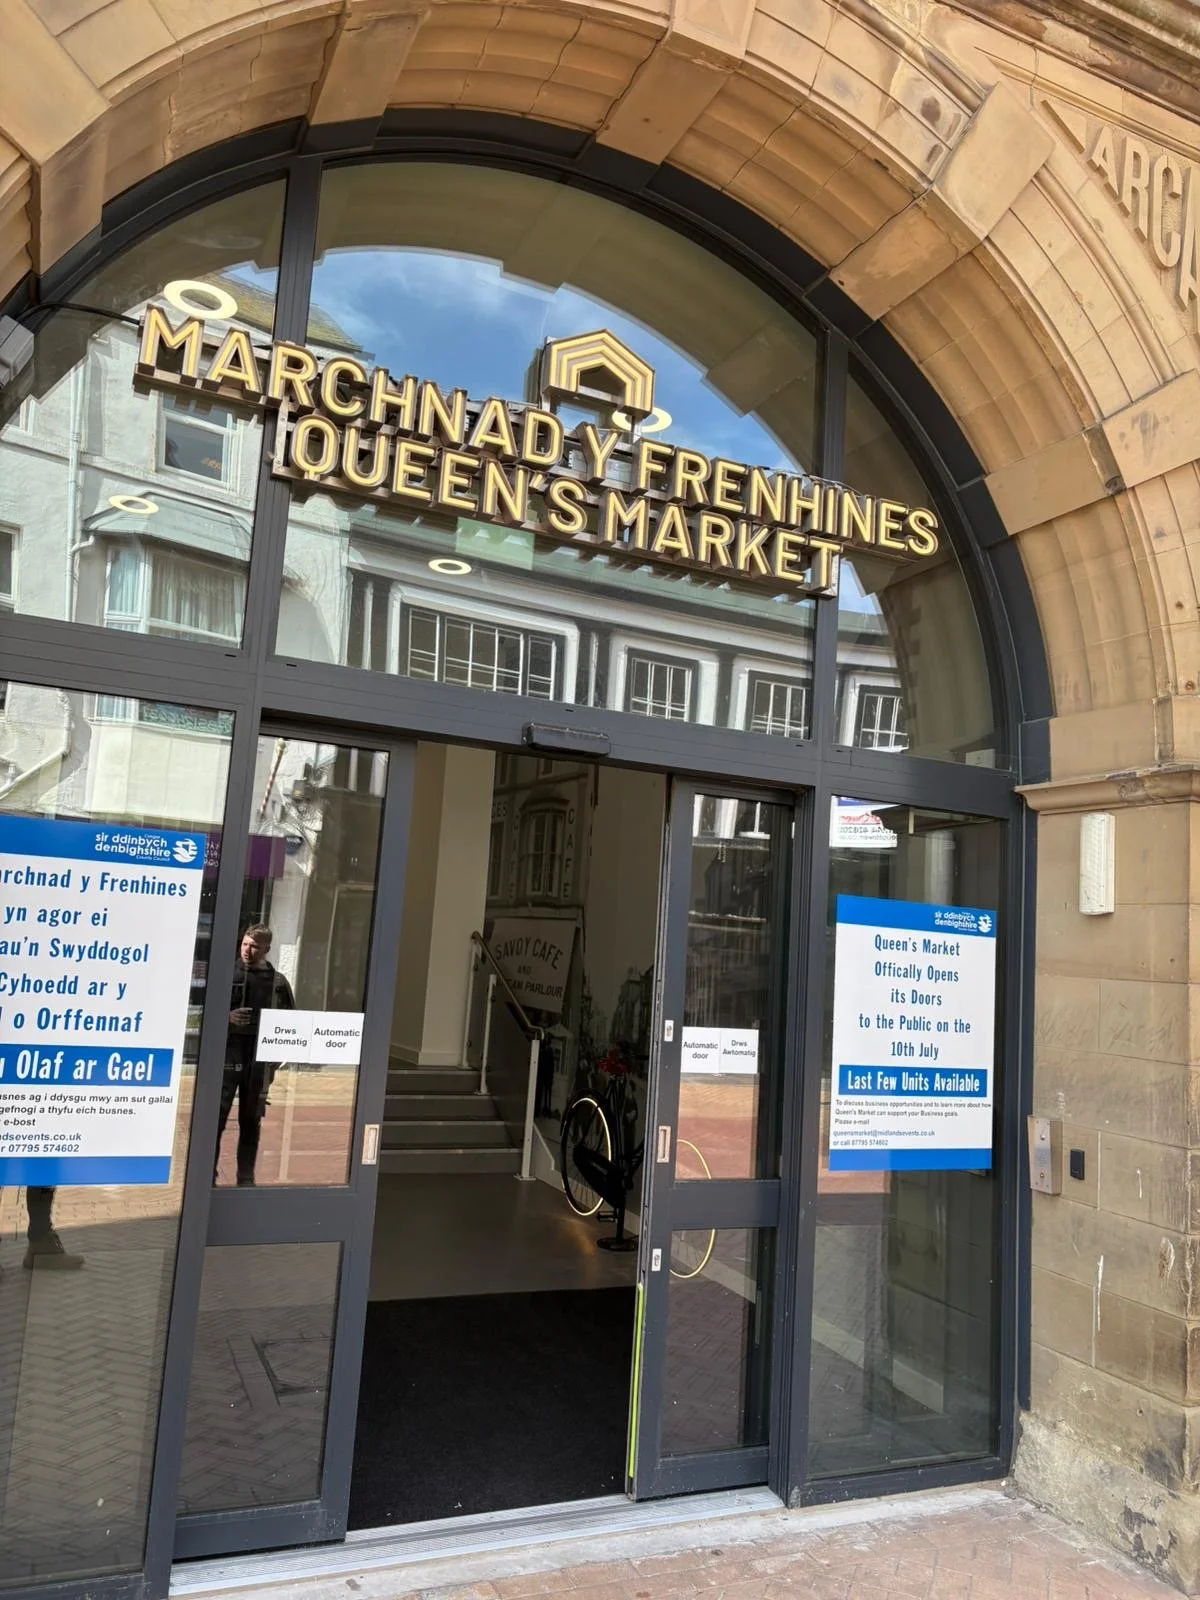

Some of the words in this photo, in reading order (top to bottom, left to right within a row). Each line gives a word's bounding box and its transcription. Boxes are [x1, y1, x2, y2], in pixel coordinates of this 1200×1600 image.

[137, 303, 564, 469] MARCHNAD
[575, 421, 623, 483] Y
[632, 437, 940, 557] FRENHINES
[290, 413, 588, 537] QUEEN'S
[602, 489, 843, 591] MARKET
[94, 842, 171, 857] denbighshire
[95, 832, 109, 842] sir
[112, 833, 168, 848] ddinbych
[0, 866, 71, 888] rchnad
[80, 875, 90, 894] y
[100, 872, 187, 897] Frenhines
[4, 905, 27, 925] yn
[37, 908, 81, 928] agor
[91, 908, 108, 927] ei
[50, 937, 149, 965] Swyddogol
[494, 936, 532, 960] SAVOY
[532, 938, 564, 970] CAFE
[874, 934, 917, 952] Queen's
[922, 938, 961, 956] Market
[874, 961, 922, 982] Offically
[927, 965, 959, 983] Opens
[0, 971, 78, 996] Cyhoedd
[88, 981, 108, 996] ar
[117, 981, 127, 1000] y
[525, 980, 564, 999] PARLOUR
[891, 988, 906, 1004] its
[911, 989, 942, 1006] Doors
[13, 1013, 25, 1029] o
[37, 1007, 143, 1033] Orffennaf
[859, 1013, 870, 1028] to
[876, 1014, 894, 1030] the
[900, 1015, 932, 1032] Public
[936, 1021, 949, 1032] on
[954, 1019, 971, 1034] the
[274, 1026, 297, 1035] Drws
[314, 1028, 360, 1037] Automatic
[261, 1037, 308, 1047] Awtomatig
[325, 1040, 347, 1048] door
[683, 1041, 718, 1049] Automatic
[891, 1041, 915, 1056] 10th
[918, 1043, 939, 1061] July
[722, 1049, 756, 1058] Awtomatig
[16, 1049, 64, 1080] Olaf
[72, 1058, 97, 1080] ar
[107, 1052, 154, 1081] Gael
[847, 1070, 872, 1090] Last
[877, 1071, 898, 1091] Few
[902, 1072, 929, 1091] Units
[933, 1073, 980, 1092] Available
[29, 1094, 42, 1103] ag
[50, 1093, 87, 1104] ddysgu
[89, 1095, 112, 1104] mwy
[131, 1095, 146, 1103] sut
[148, 1095, 173, 1105] gallai
[0, 1105, 37, 1115] gefnogi
[39, 1106, 45, 1114] a
[48, 1105, 74, 1115] thyfu
[76, 1106, 96, 1114] eich
[99, 1106, 136, 1115] busnes.
[3, 1117, 36, 1126] e-bost
[0, 1132, 82, 1141] dsevents.co.uk
[8, 1144, 40, 1153] 07795
[43, 1144, 80, 1153] 574602
